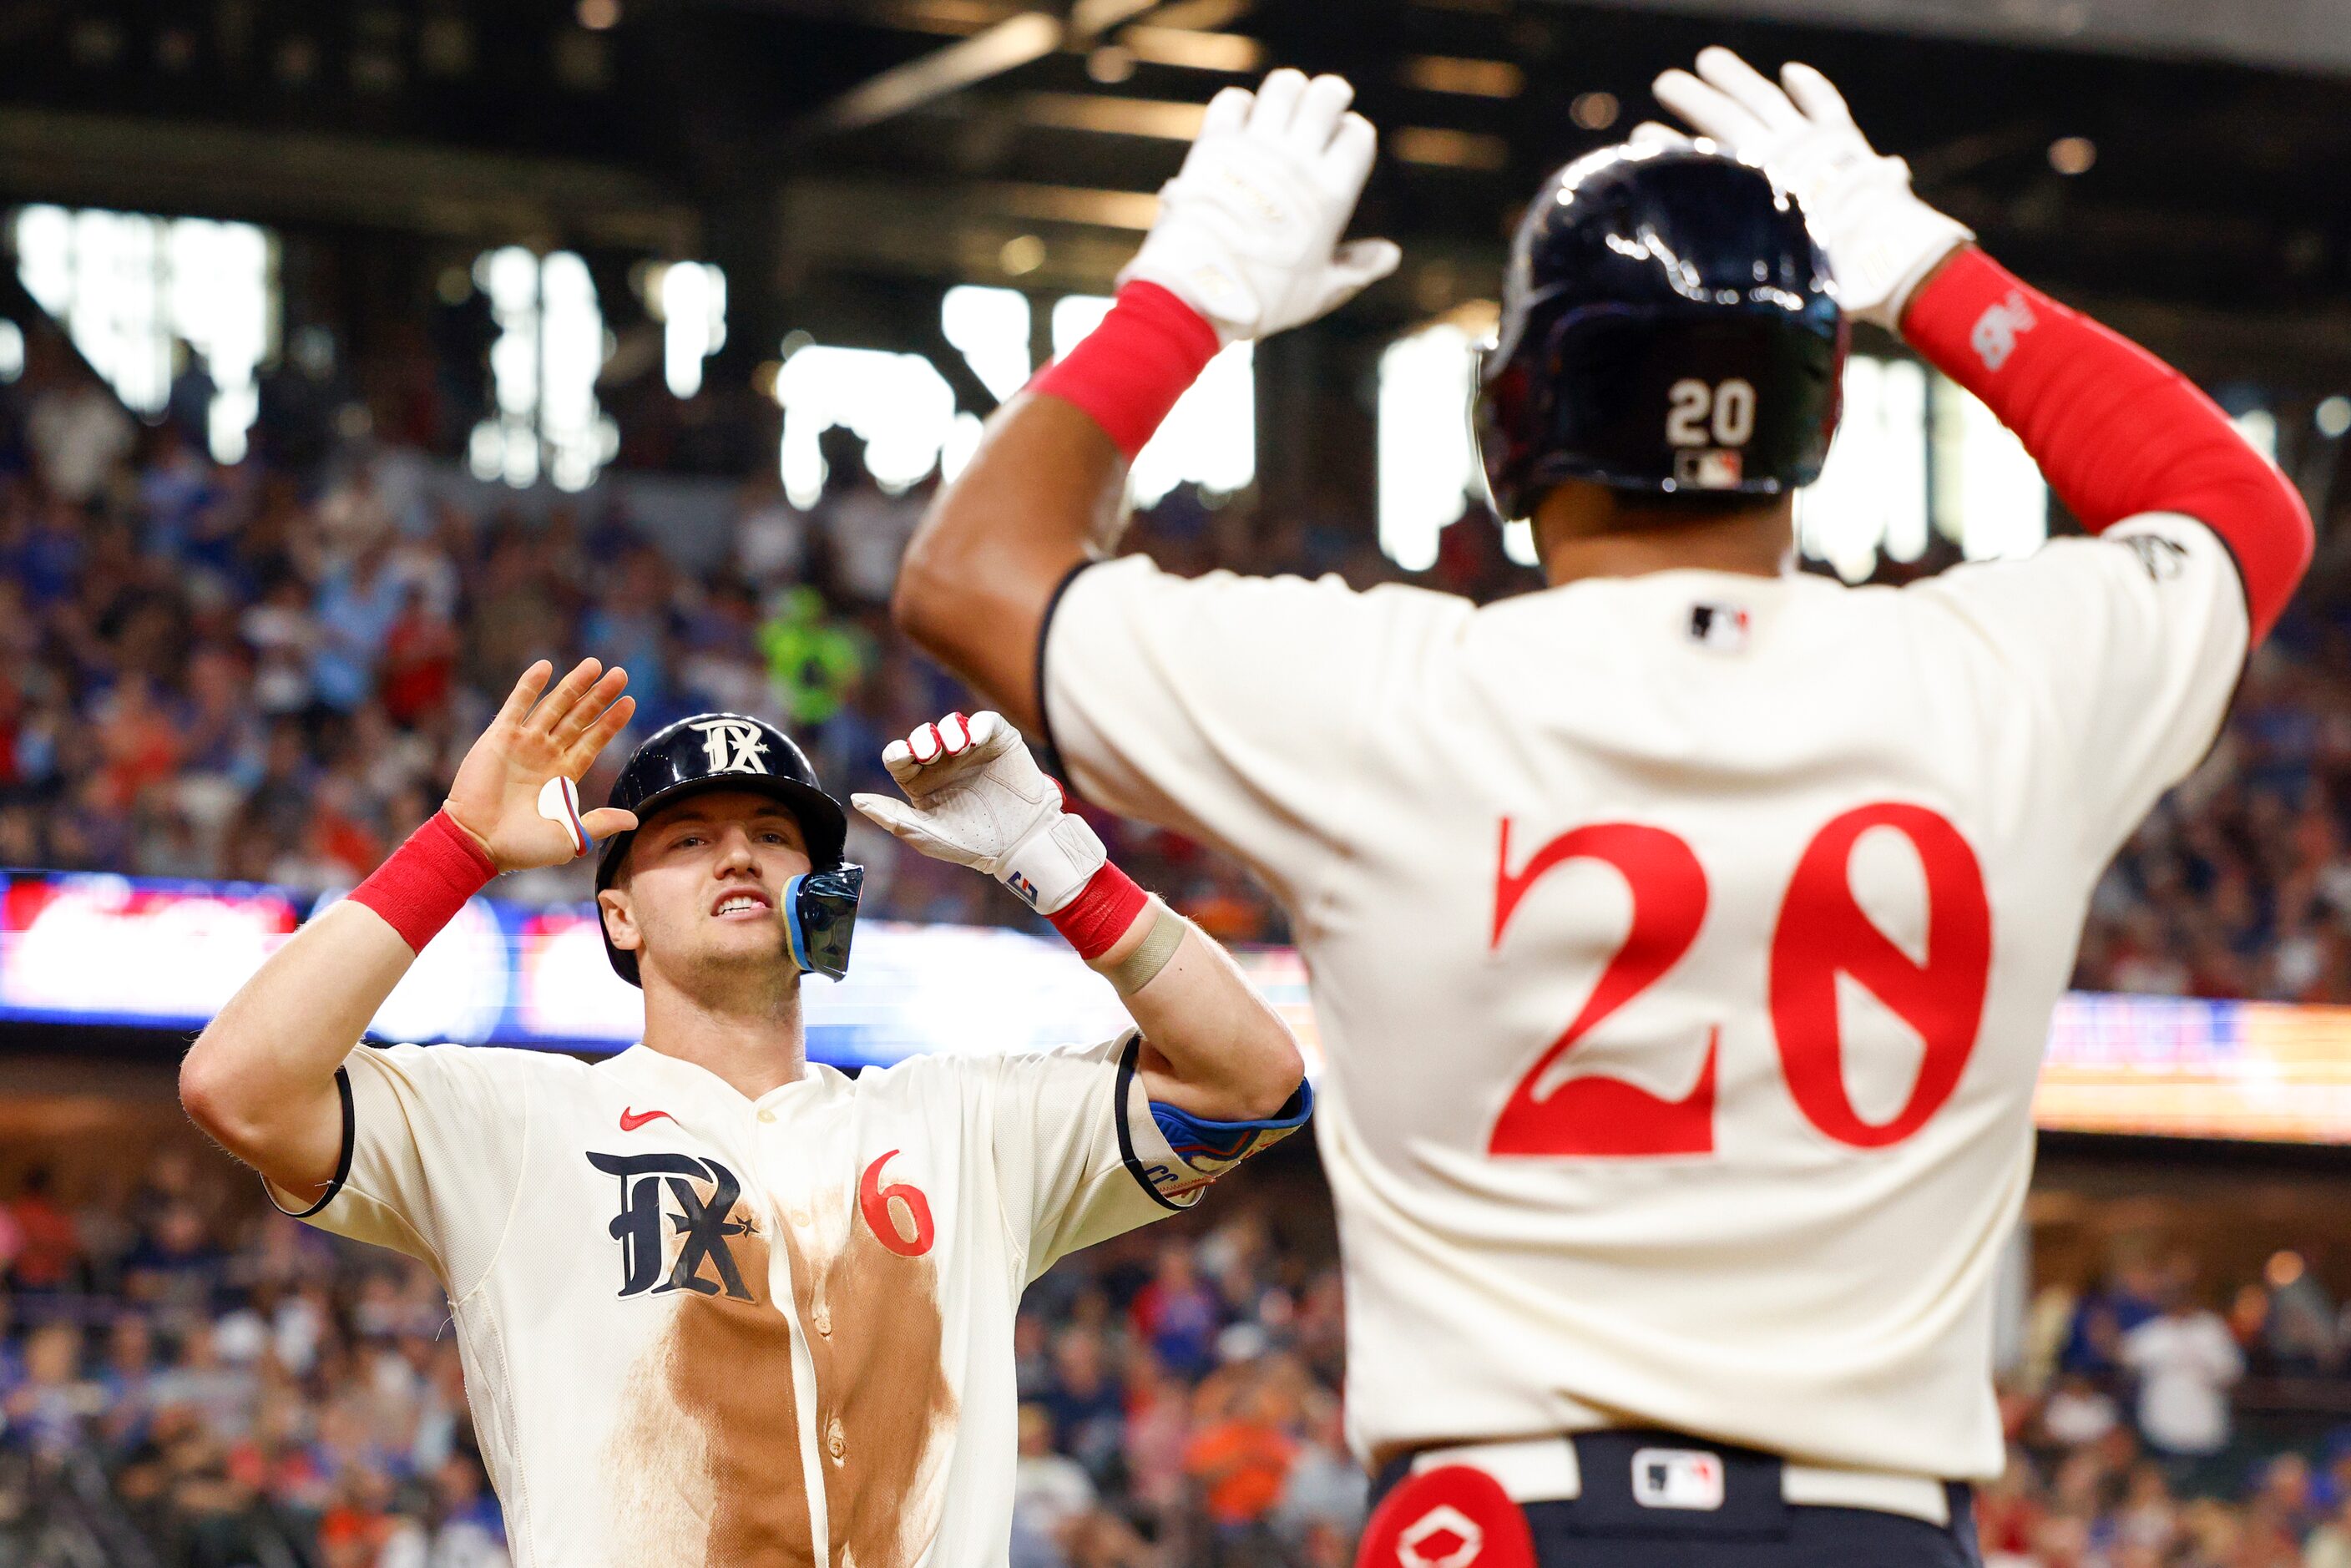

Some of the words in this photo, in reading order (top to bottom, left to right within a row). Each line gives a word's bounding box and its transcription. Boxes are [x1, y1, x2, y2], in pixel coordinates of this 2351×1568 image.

[1666, 377, 1757, 447] 20
[1486, 802, 1993, 1156] 20
[860, 1149, 935, 1257] 6
